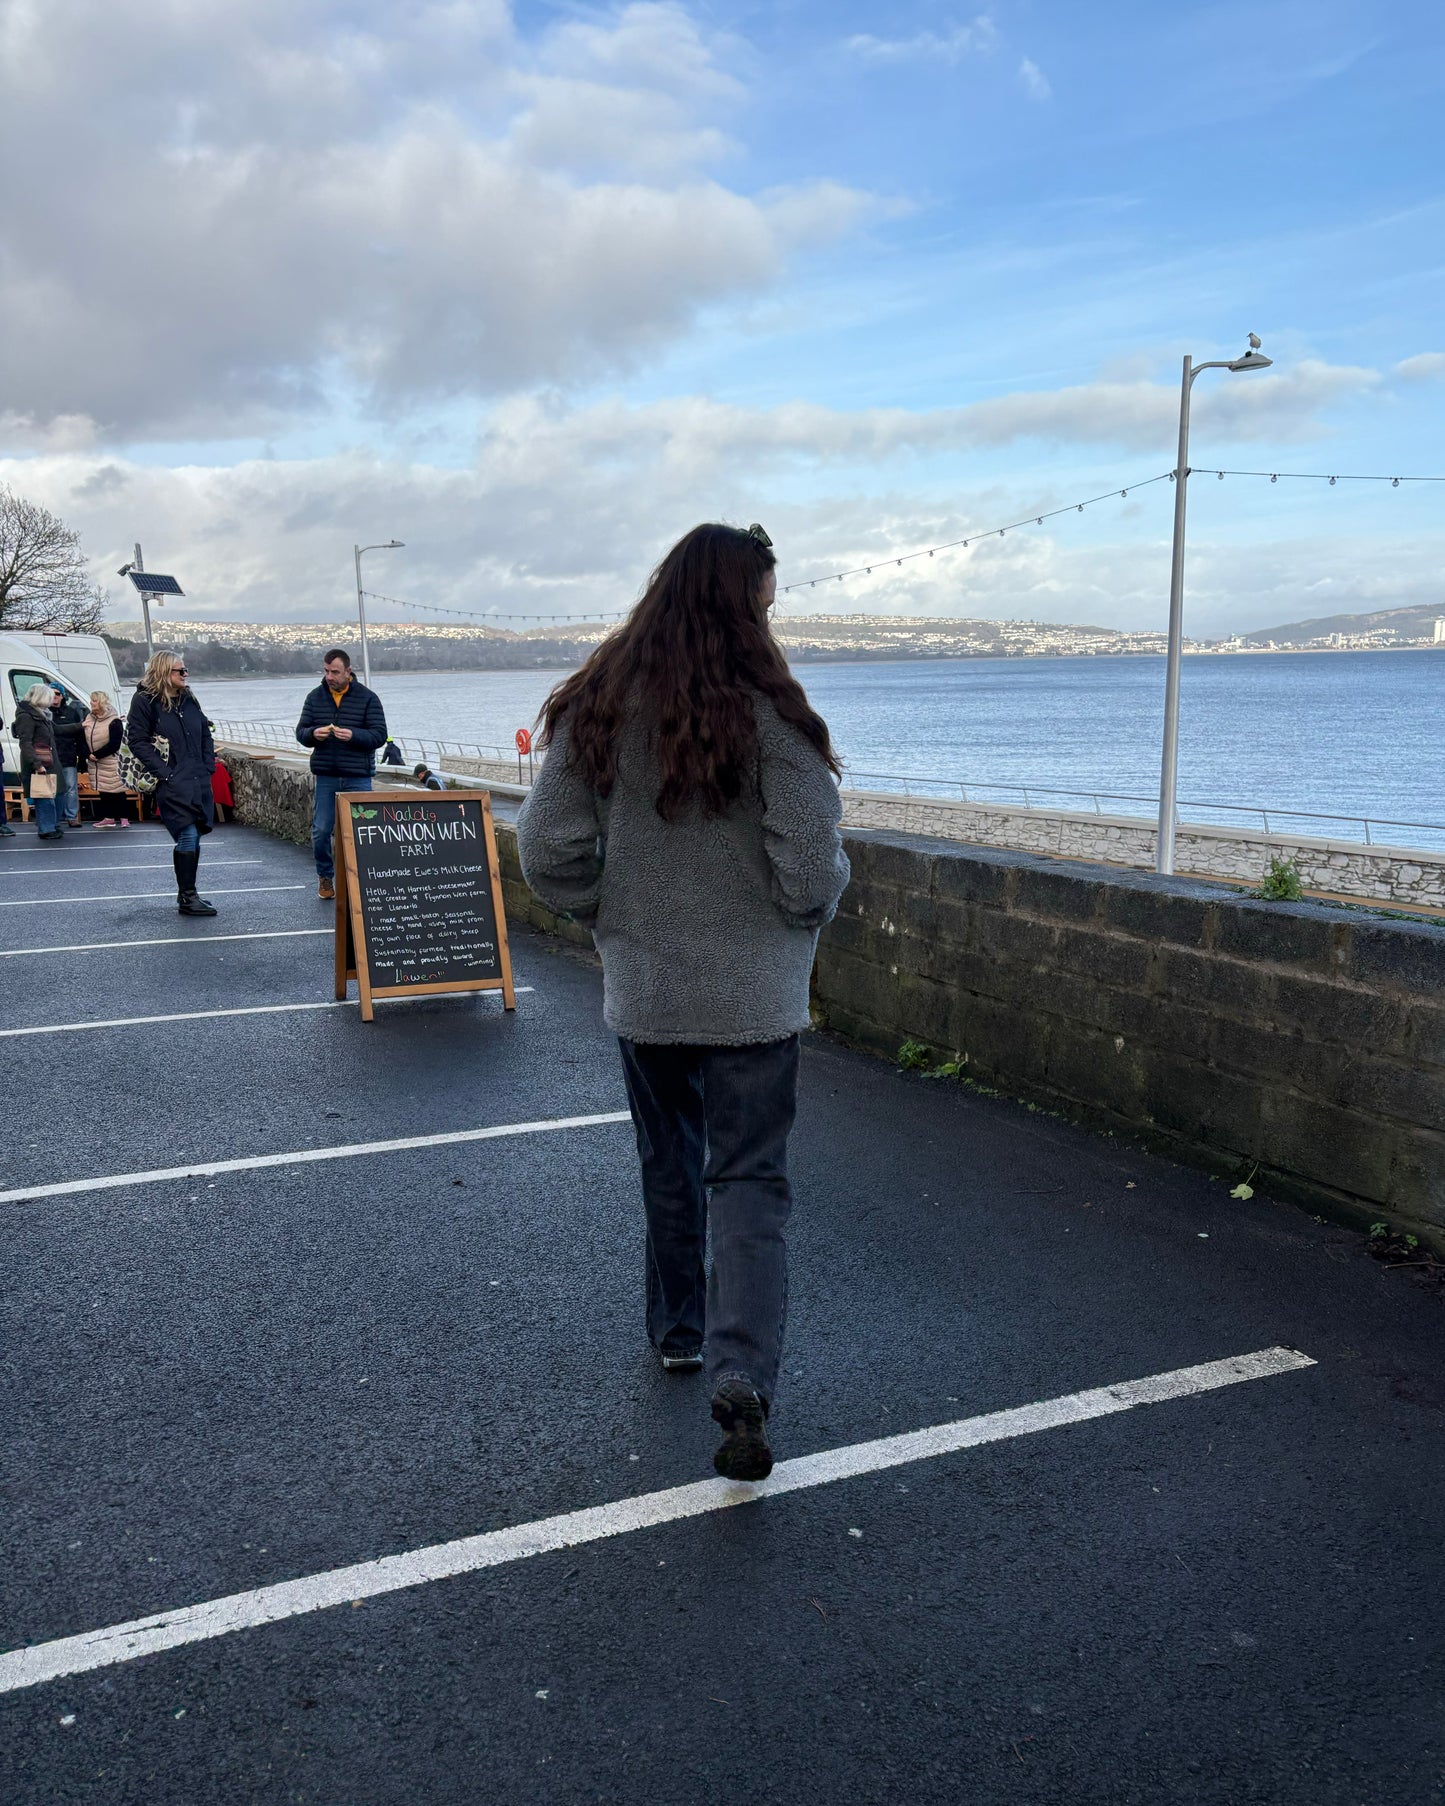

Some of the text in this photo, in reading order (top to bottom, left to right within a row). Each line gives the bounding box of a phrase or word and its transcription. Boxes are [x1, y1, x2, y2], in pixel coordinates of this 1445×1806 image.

[382, 804, 437, 823] Nadolig
[357, 821, 477, 846] FFYNNON WEN
[400, 843, 435, 857] FARM
[367, 865, 483, 880] Handmade Ewe's Milk Cheese
[393, 886, 406, 894] I'm
[407, 884, 432, 893] Harriet
[437, 880, 476, 890] cheesemaker
[444, 910, 475, 919] seasonal
[396, 924, 405, 932] by
[428, 920, 447, 930] using
[371, 937, 385, 947] my
[405, 933, 422, 942] flock
[427, 932, 434, 940] of
[438, 931, 458, 940] dairy
[460, 928, 479, 936] sheep
[374, 948, 417, 958] Sustainably
[450, 941, 494, 951] traditionally
[420, 954, 449, 966] proudly
[452, 953, 473, 961] award
